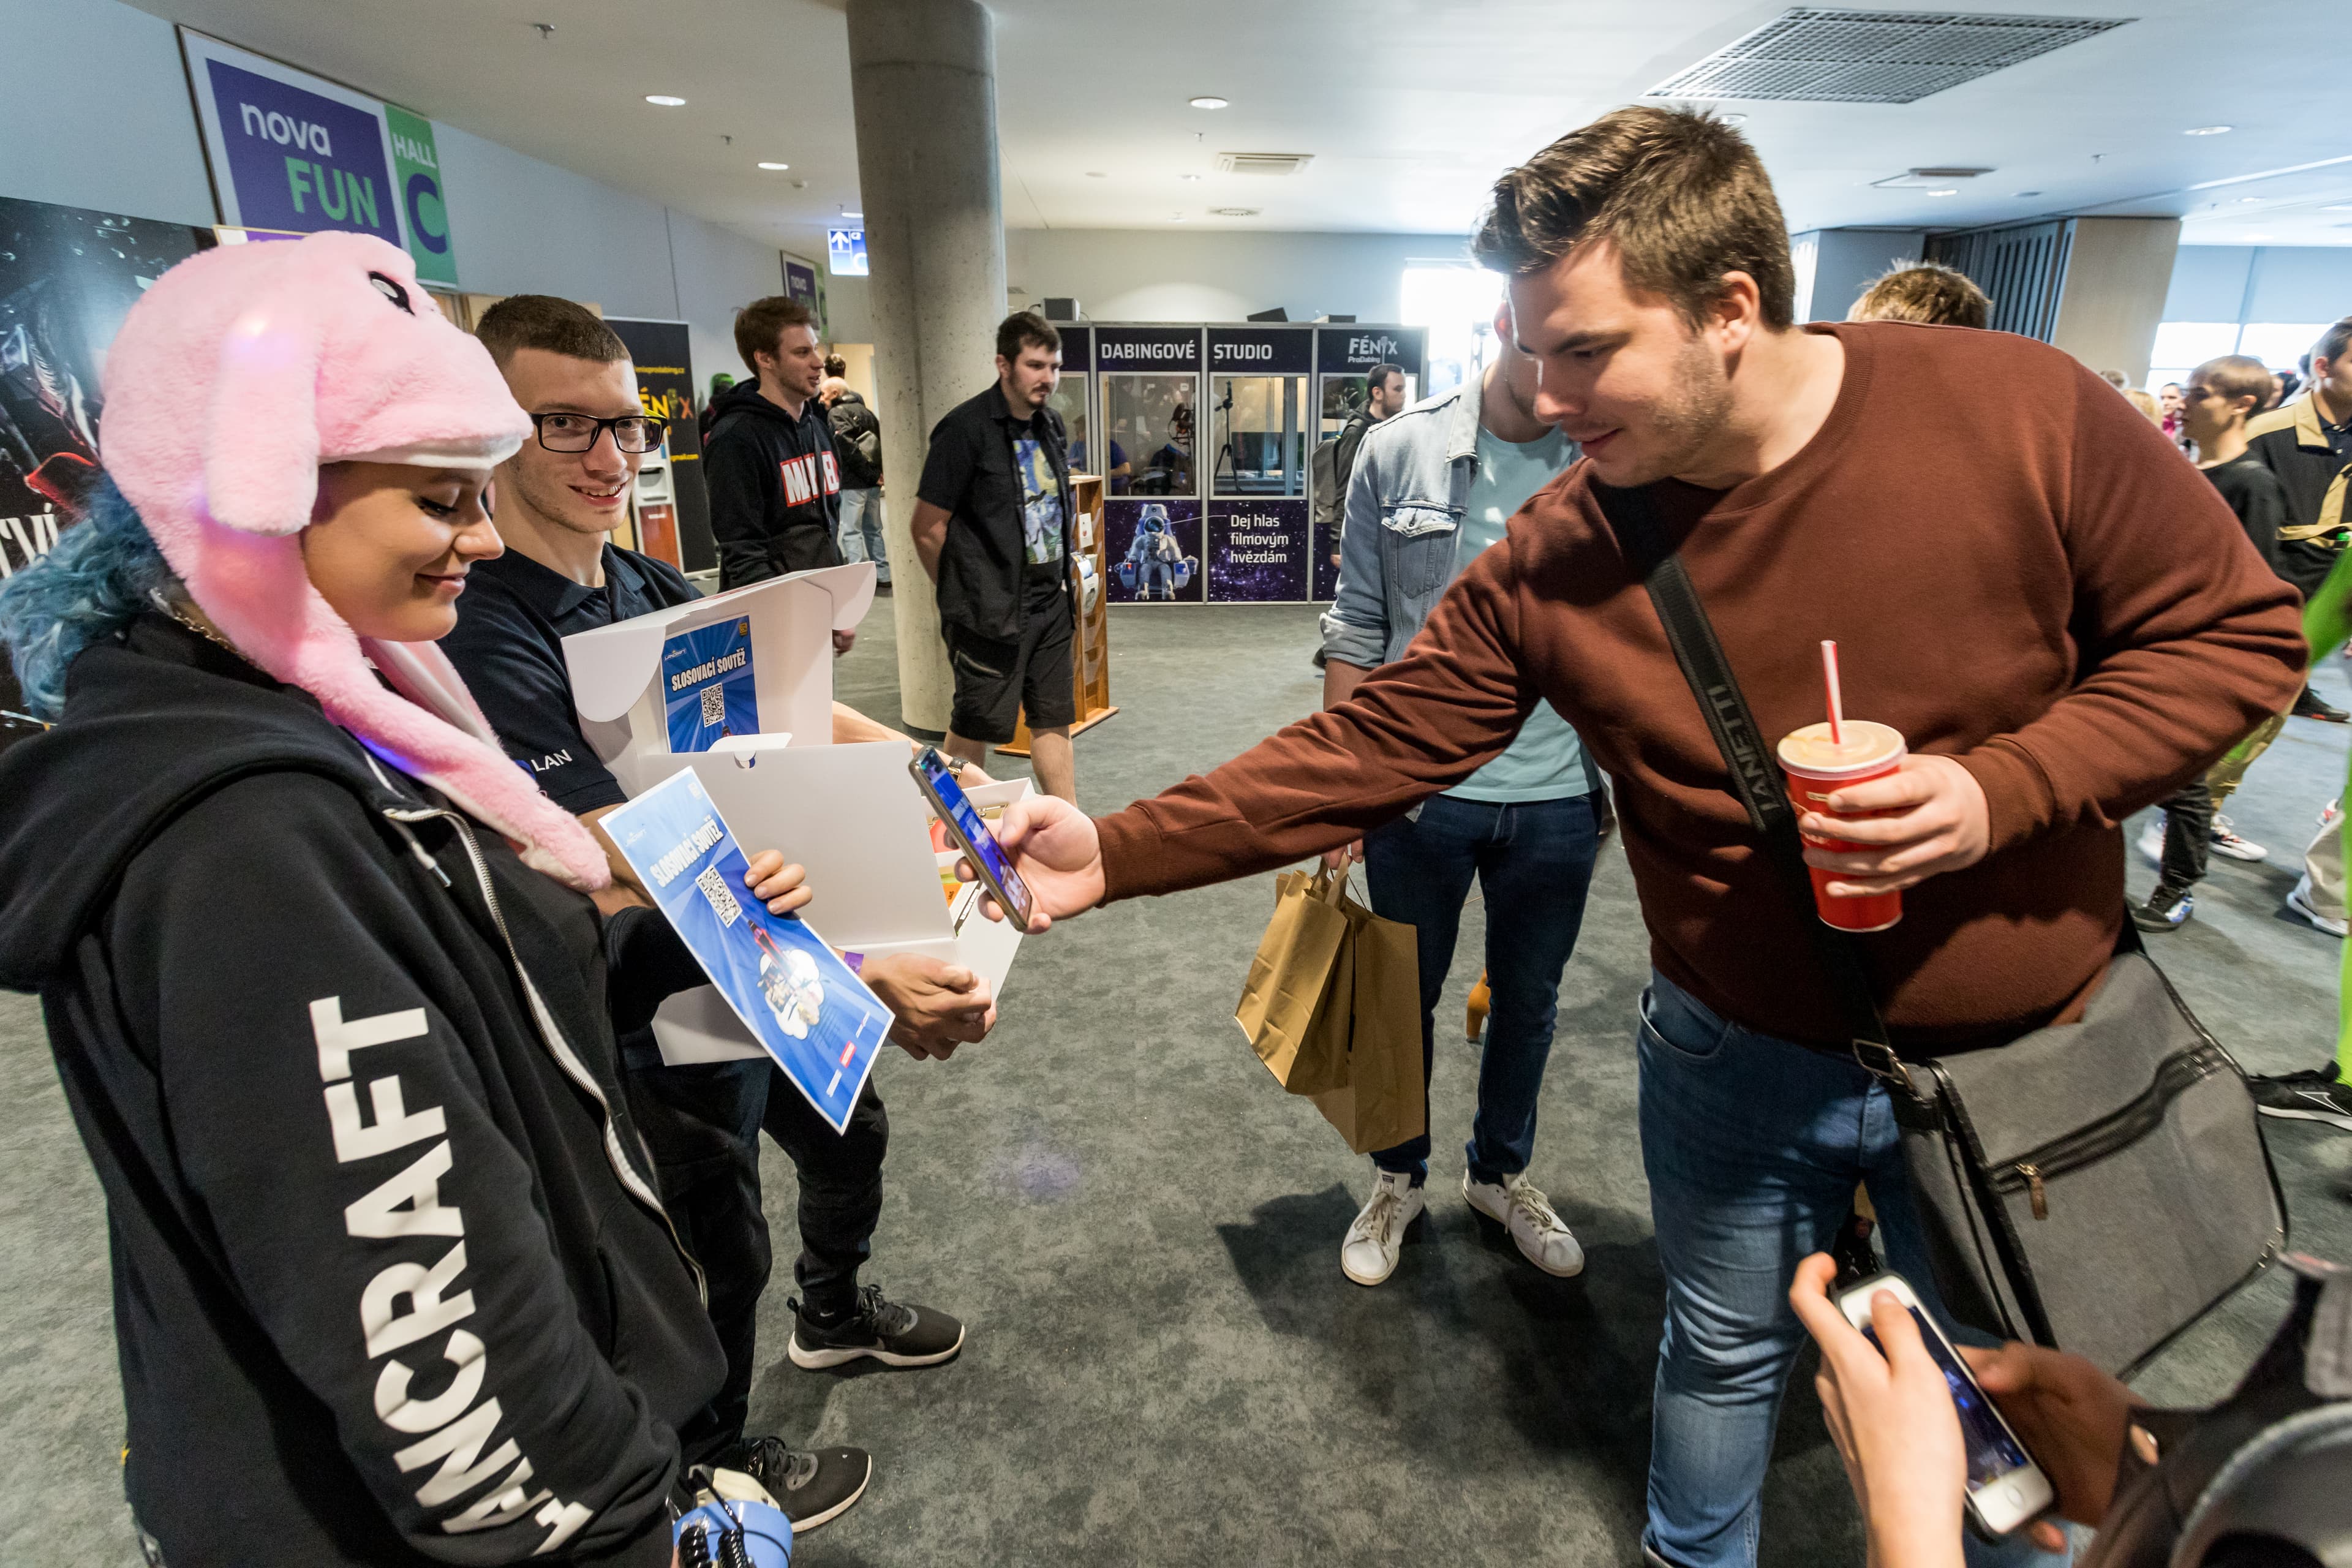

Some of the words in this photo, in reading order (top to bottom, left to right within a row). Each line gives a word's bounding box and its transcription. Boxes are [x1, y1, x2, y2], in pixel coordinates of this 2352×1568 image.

[239, 102, 333, 157] nova
[392, 132, 437, 168] HALL
[284, 156, 380, 229] FUN
[406, 173, 447, 254] C
[1101, 339, 1196, 360] DABINGOVÉ
[1213, 344, 1273, 360] STUDIO
[782, 454, 839, 504] MAEL
[1230, 532, 1289, 546] filmovým
[1231, 514, 1251, 530] Dej
[1253, 514, 1280, 528] hlas
[1230, 548, 1287, 564] hvězdám
[671, 656, 716, 692] SLOSOVACÍ
[717, 647, 746, 674] SOUTĚŽ
[530, 748, 573, 772] LAN
